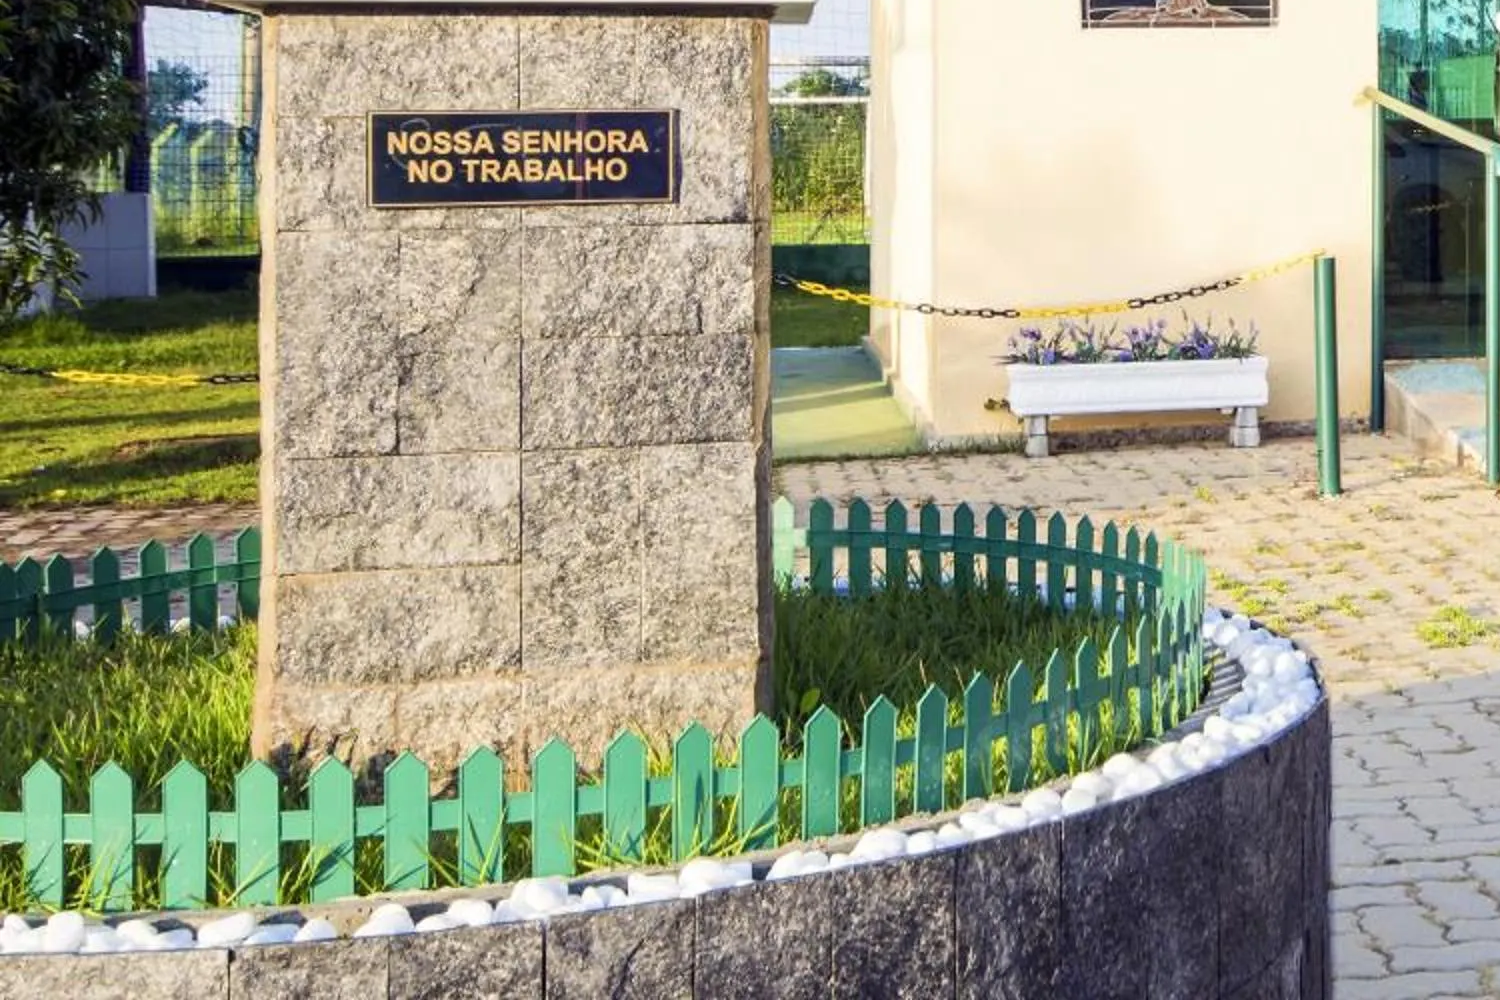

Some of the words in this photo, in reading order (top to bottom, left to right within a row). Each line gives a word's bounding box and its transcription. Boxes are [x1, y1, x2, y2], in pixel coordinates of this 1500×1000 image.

[387, 131, 495, 155] NOSSA
[502, 130, 649, 154] SENHORA
[407, 160, 453, 183] NO
[461, 158, 629, 183] TRABALHO
